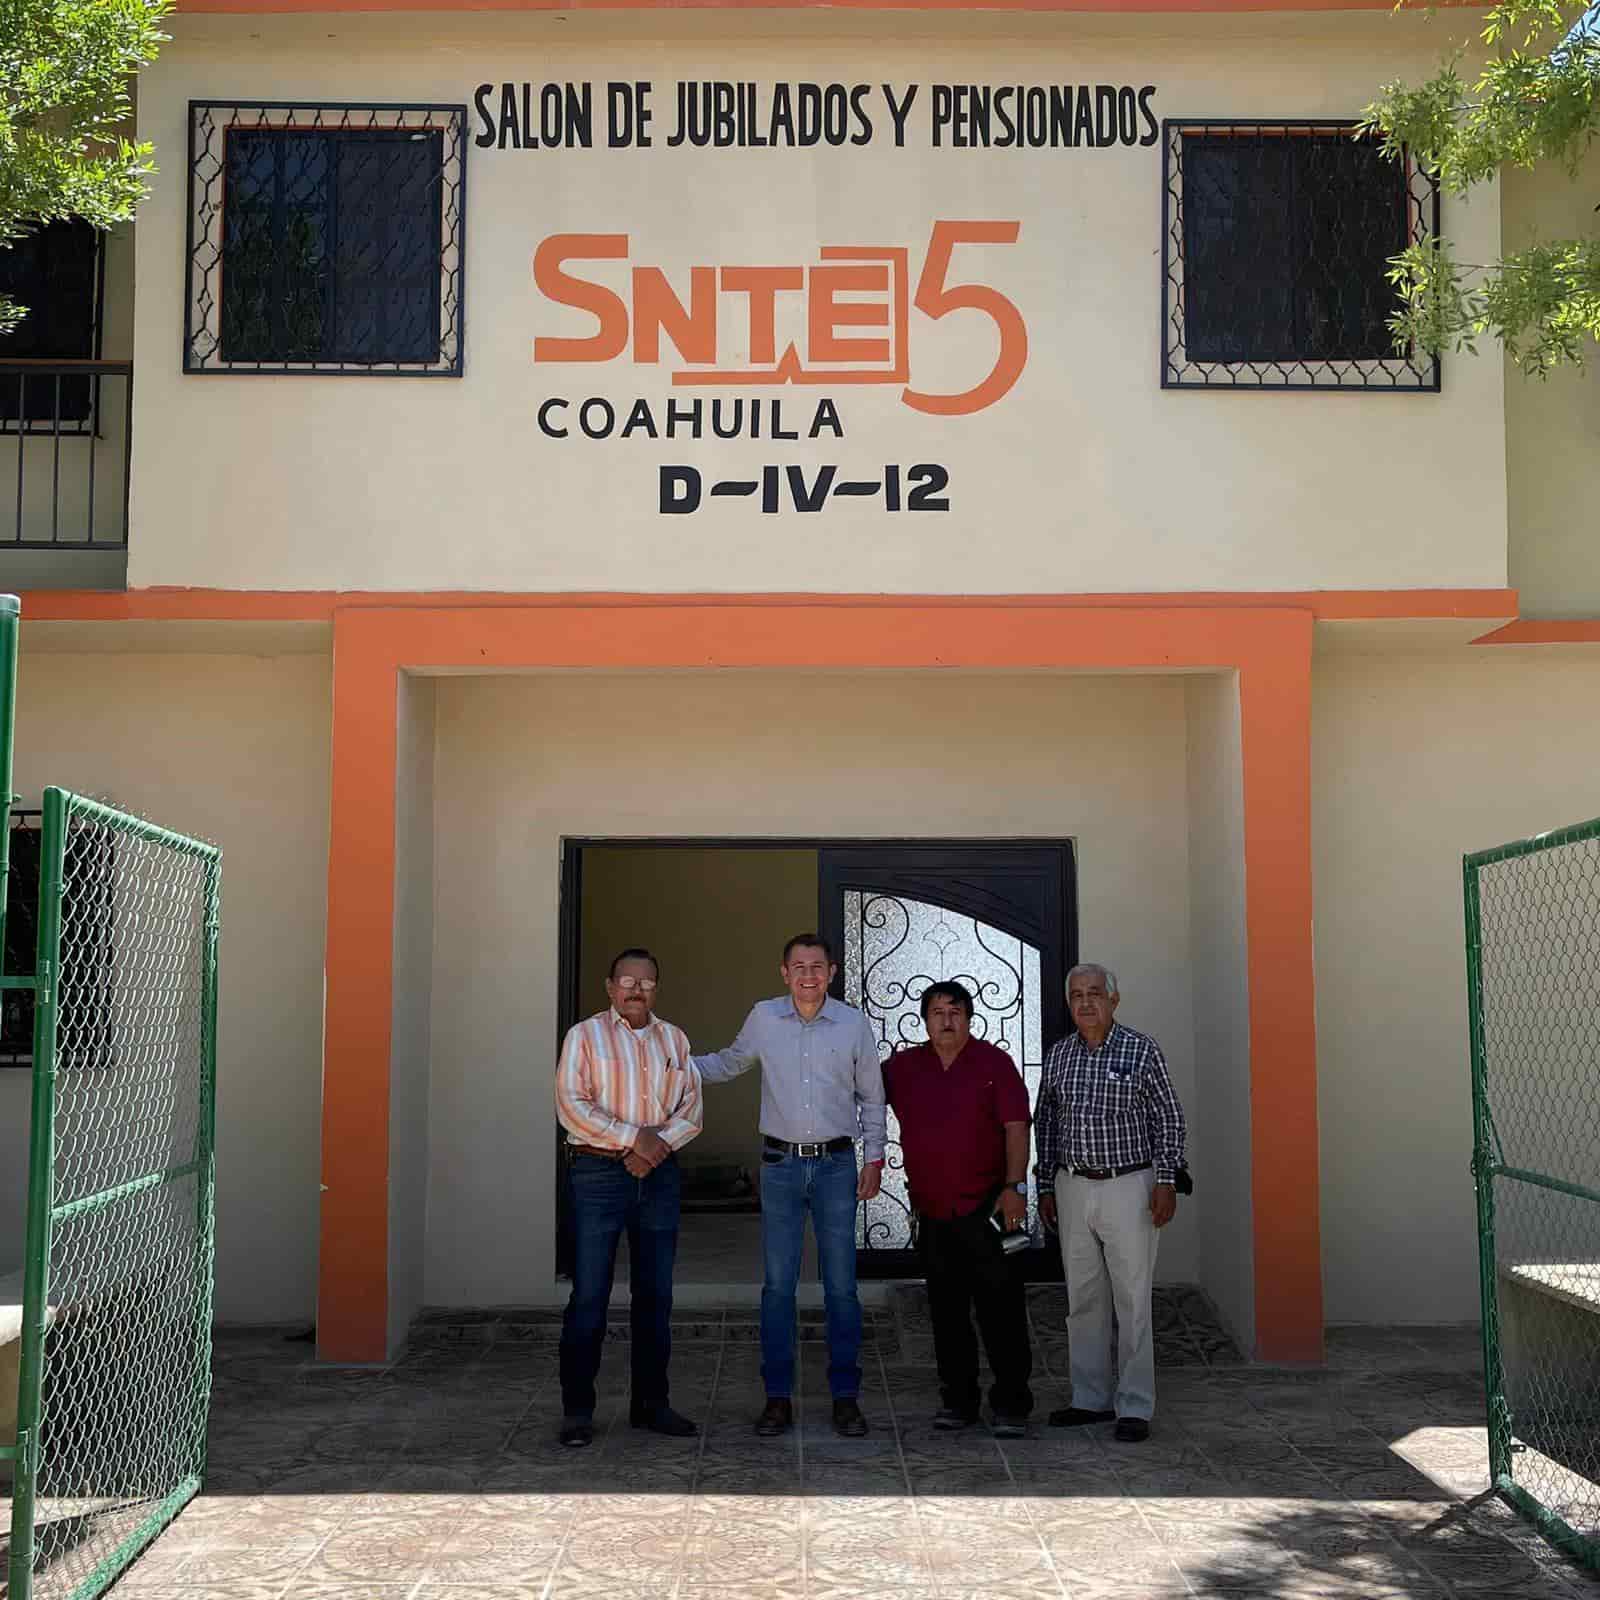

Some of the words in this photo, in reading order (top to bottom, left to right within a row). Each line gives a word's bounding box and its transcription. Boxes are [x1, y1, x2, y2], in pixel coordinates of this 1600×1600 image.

[474, 82, 593, 150] SALON
[607, 81, 653, 149] DE
[666, 81, 873, 148] JUBILADOS
[881, 83, 919, 148] Y
[932, 84, 1159, 148] PENSIONADOS
[537, 398, 844, 440] COAHUILA
[659, 463, 950, 514] D-IV-12
